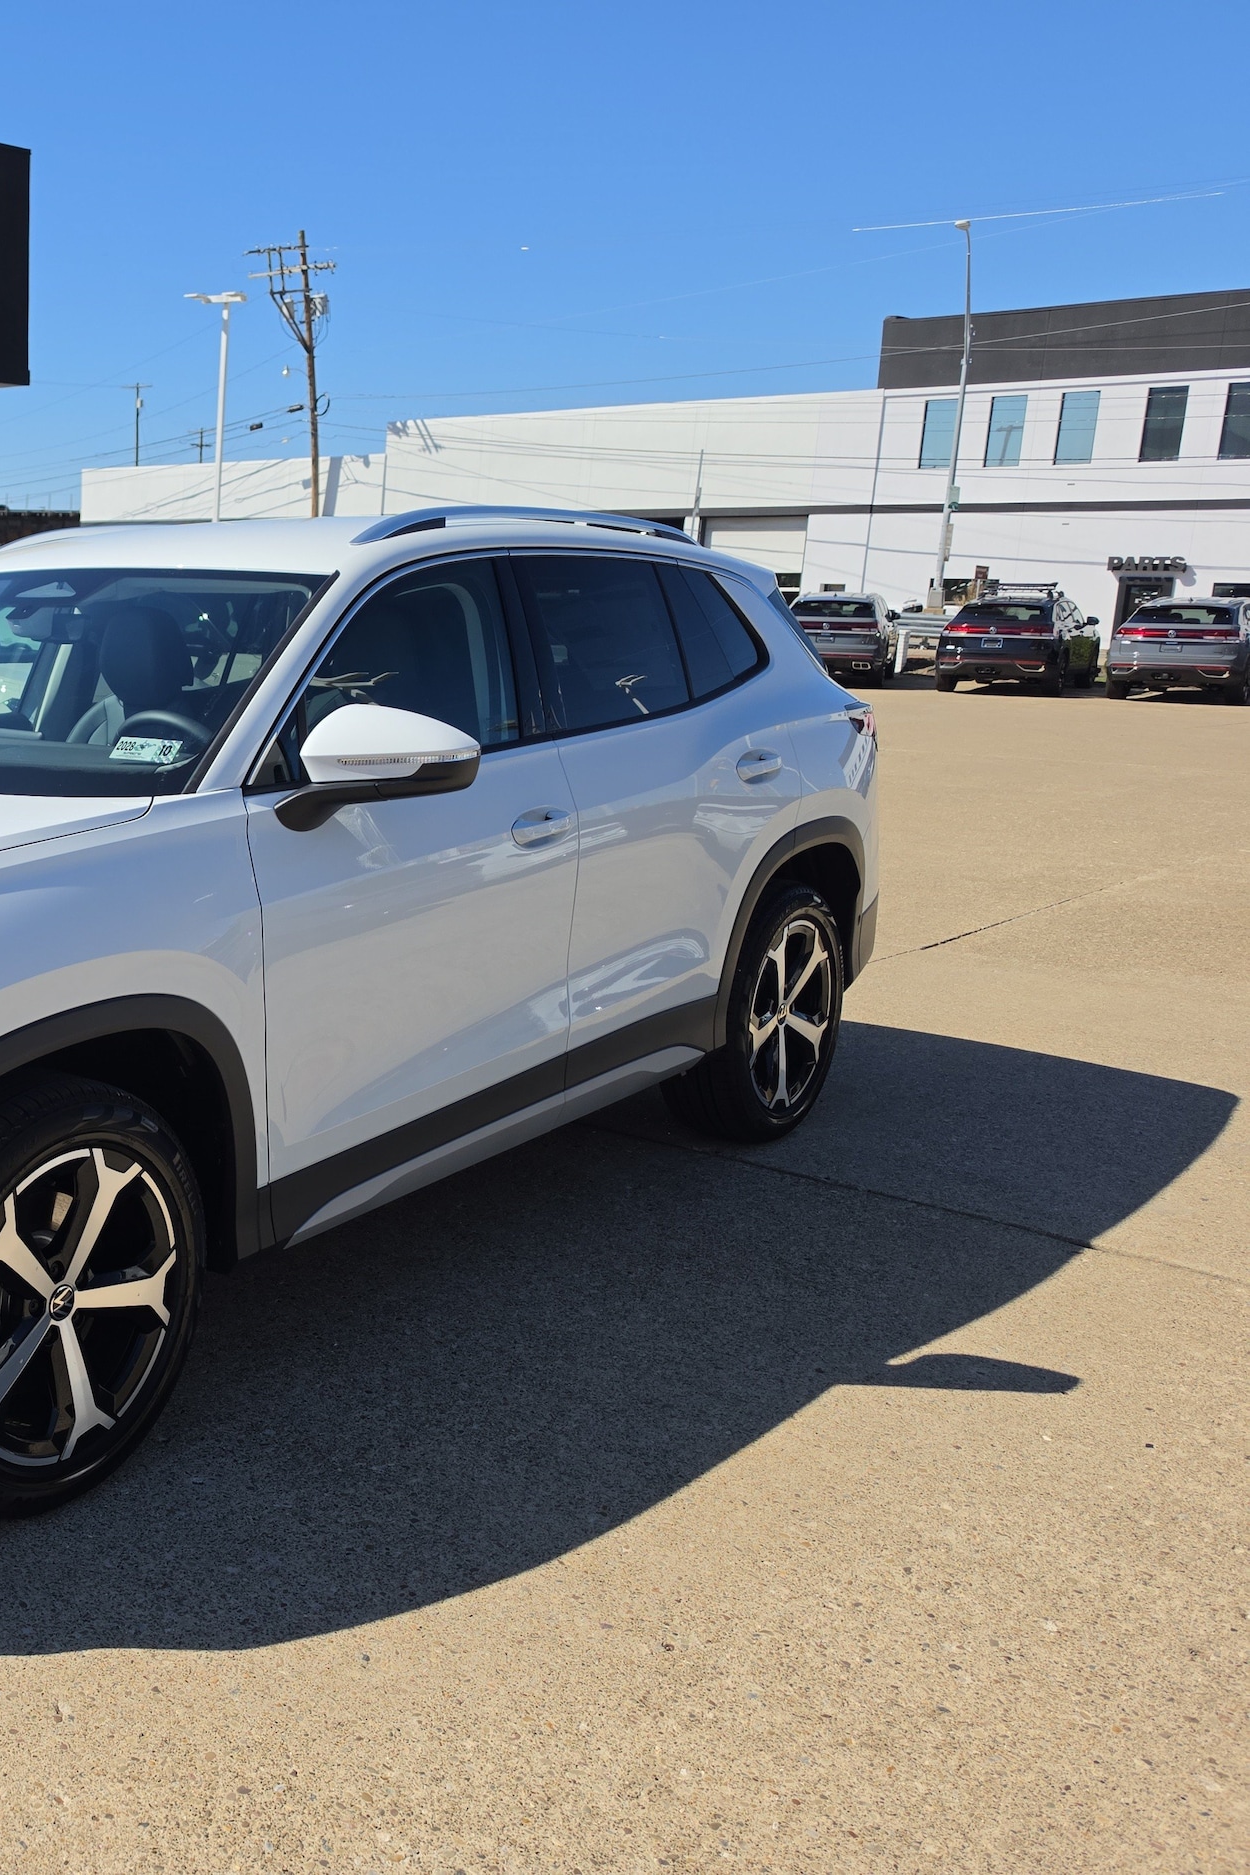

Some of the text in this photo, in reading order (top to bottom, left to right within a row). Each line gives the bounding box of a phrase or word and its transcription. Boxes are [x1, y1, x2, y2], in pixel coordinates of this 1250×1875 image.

[1107, 556, 1187, 573] PARTS
[116, 741, 173, 757] 2028 10
